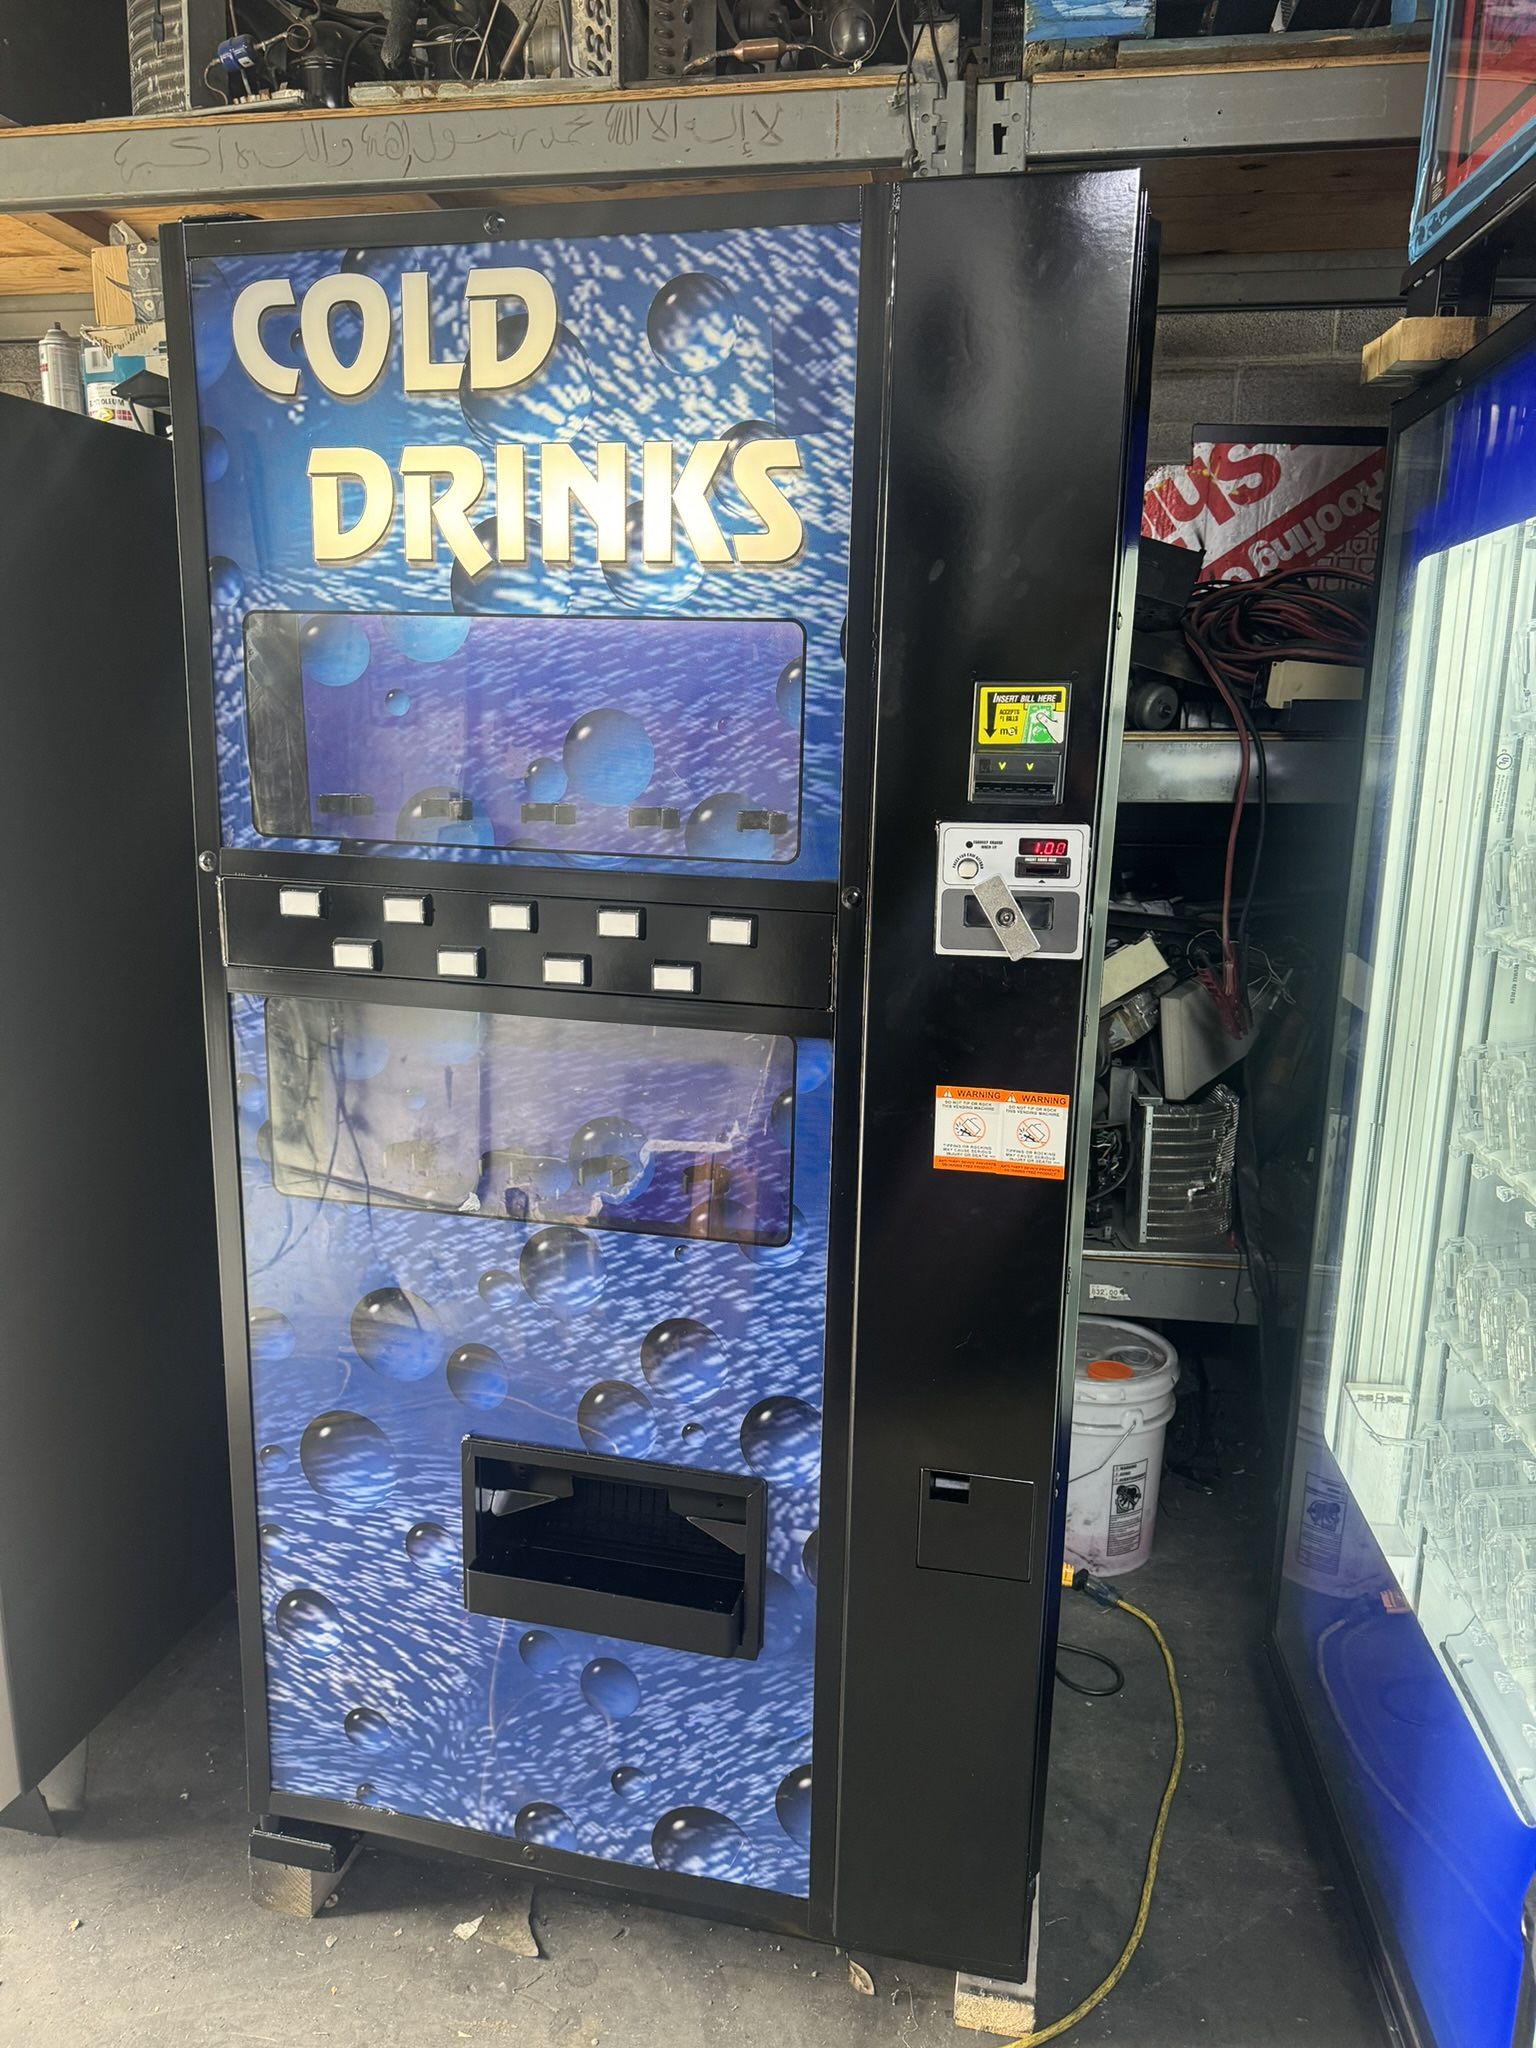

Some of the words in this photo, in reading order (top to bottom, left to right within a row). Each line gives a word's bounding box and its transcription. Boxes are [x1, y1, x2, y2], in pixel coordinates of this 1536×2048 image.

[232, 267, 558, 396] COLD
[306, 439, 805, 578] DRINKS
[1248, 468, 1385, 577] Roofing
[993, 692, 1019, 703] INSERT
[1020, 694, 1036, 703] BILL
[1037, 694, 1057, 702] HERE
[1000, 725, 1018, 737] mei
[1034, 842, 1067, 855] 1.00
[957, 1089, 1001, 1099] WARNING
[1021, 1095, 1066, 1105] WARNING
